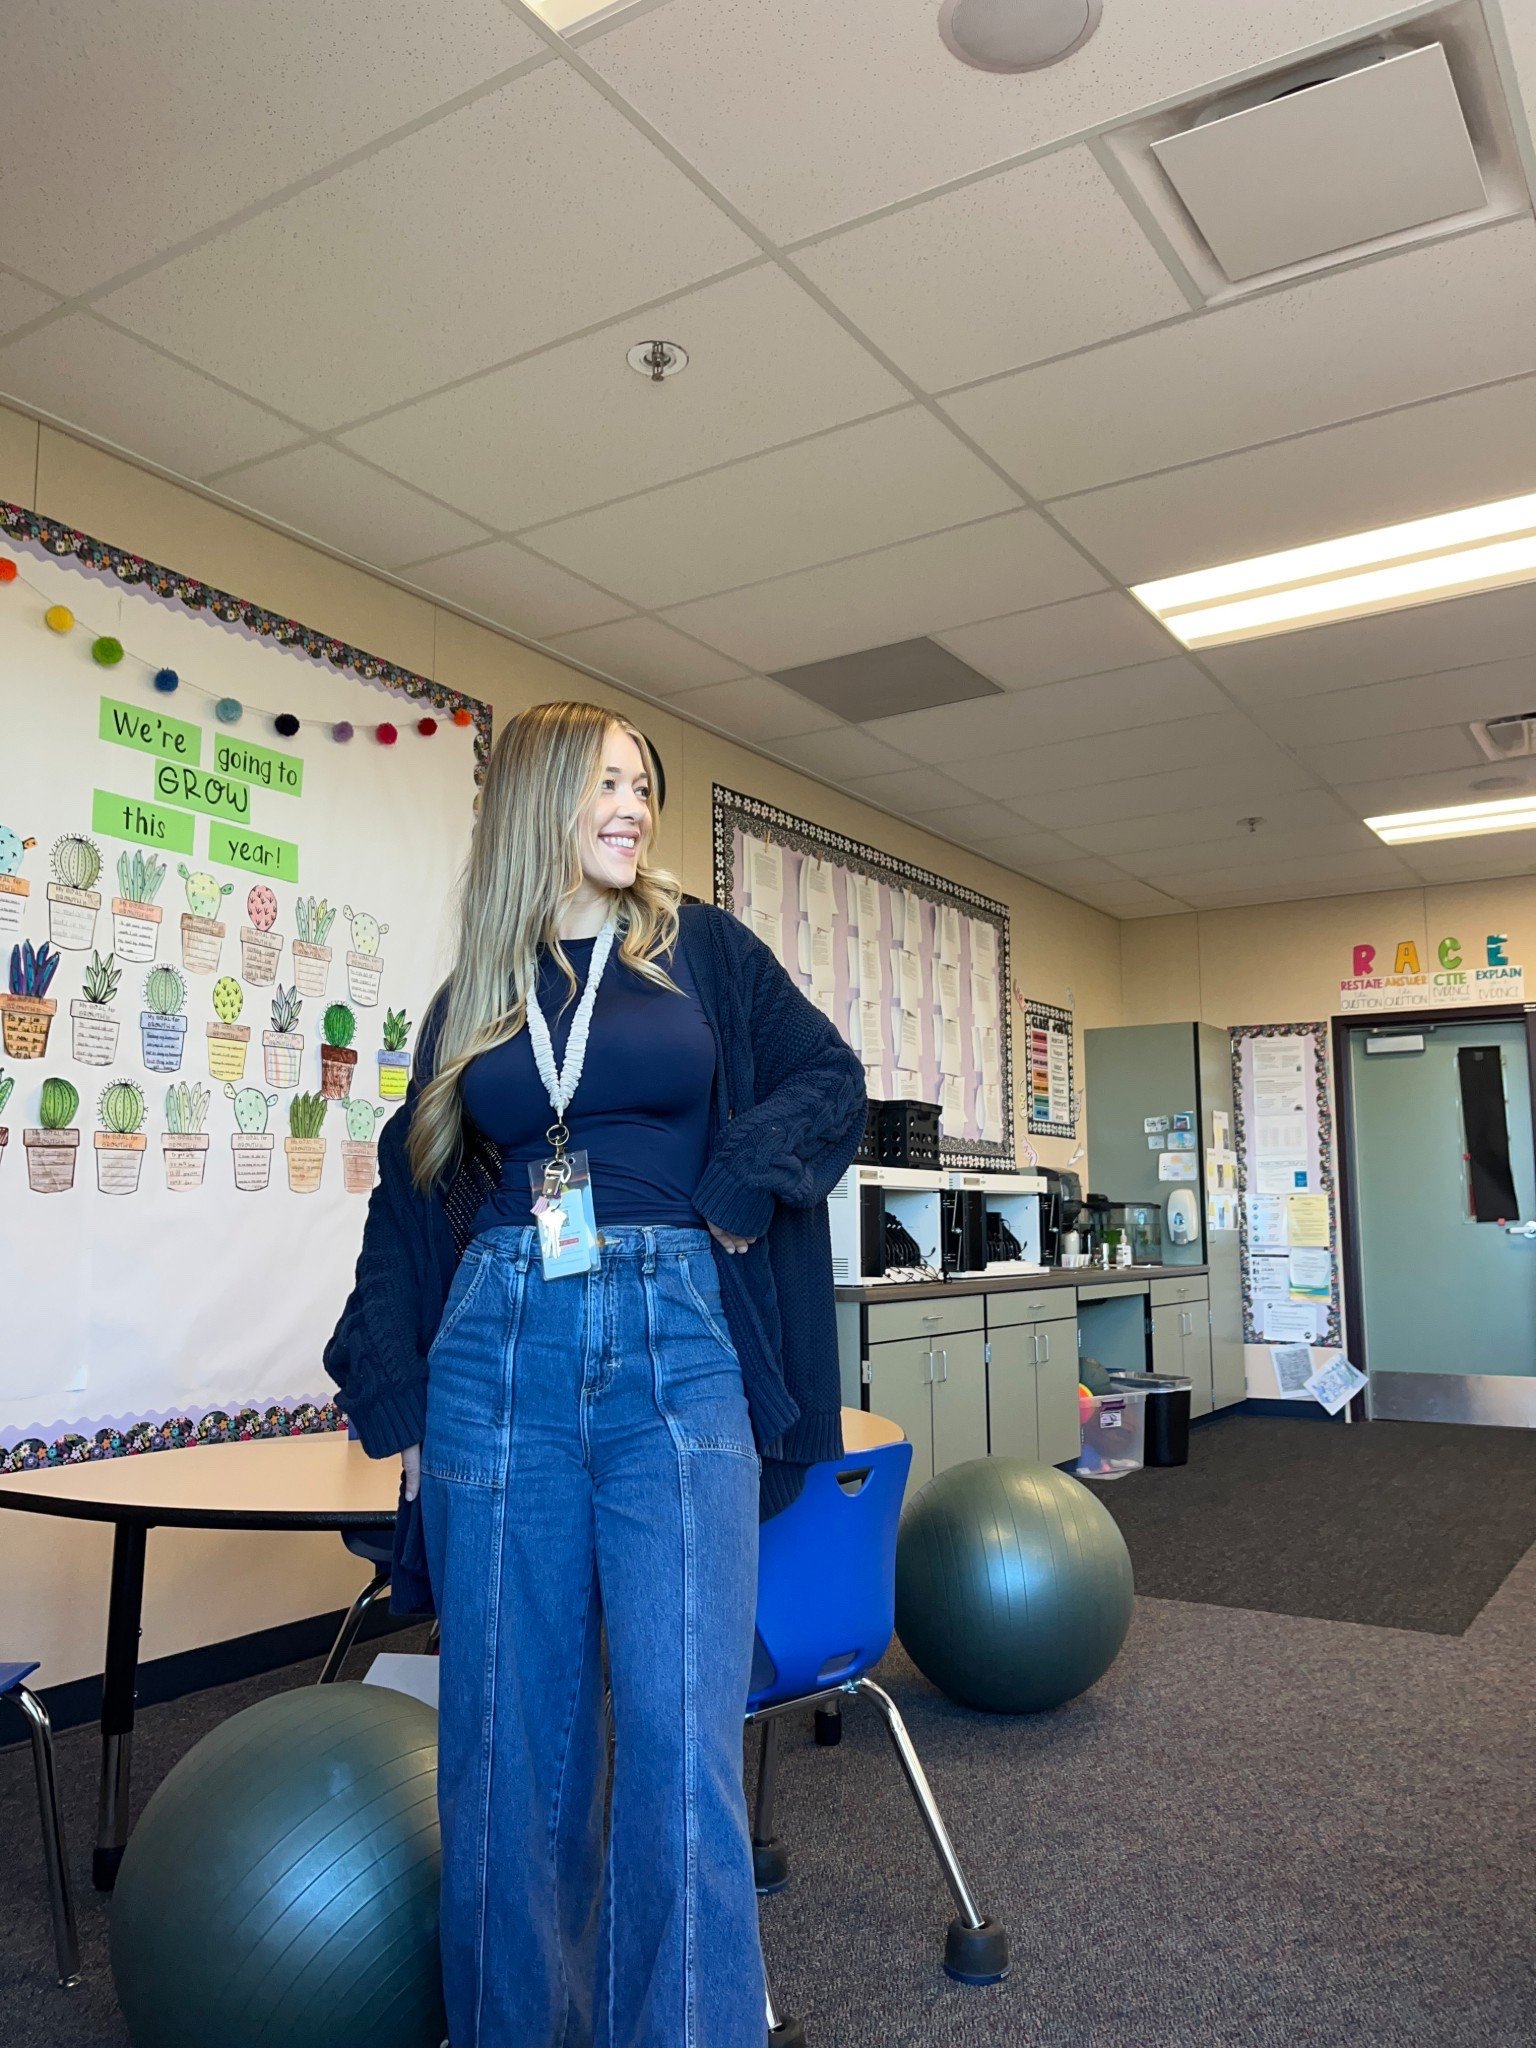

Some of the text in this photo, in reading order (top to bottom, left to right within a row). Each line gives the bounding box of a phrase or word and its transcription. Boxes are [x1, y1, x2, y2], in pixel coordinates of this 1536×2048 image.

[113, 709, 187, 753] We're
[218, 747, 298, 786] going to
[158, 766, 249, 813] GROW
[122, 806, 166, 839] this
[228, 839, 281, 869] year!
[1353, 934, 1508, 976] R A C E
[1341, 968, 1522, 991] RESTATE ANSWER CITE EXPLAIN
